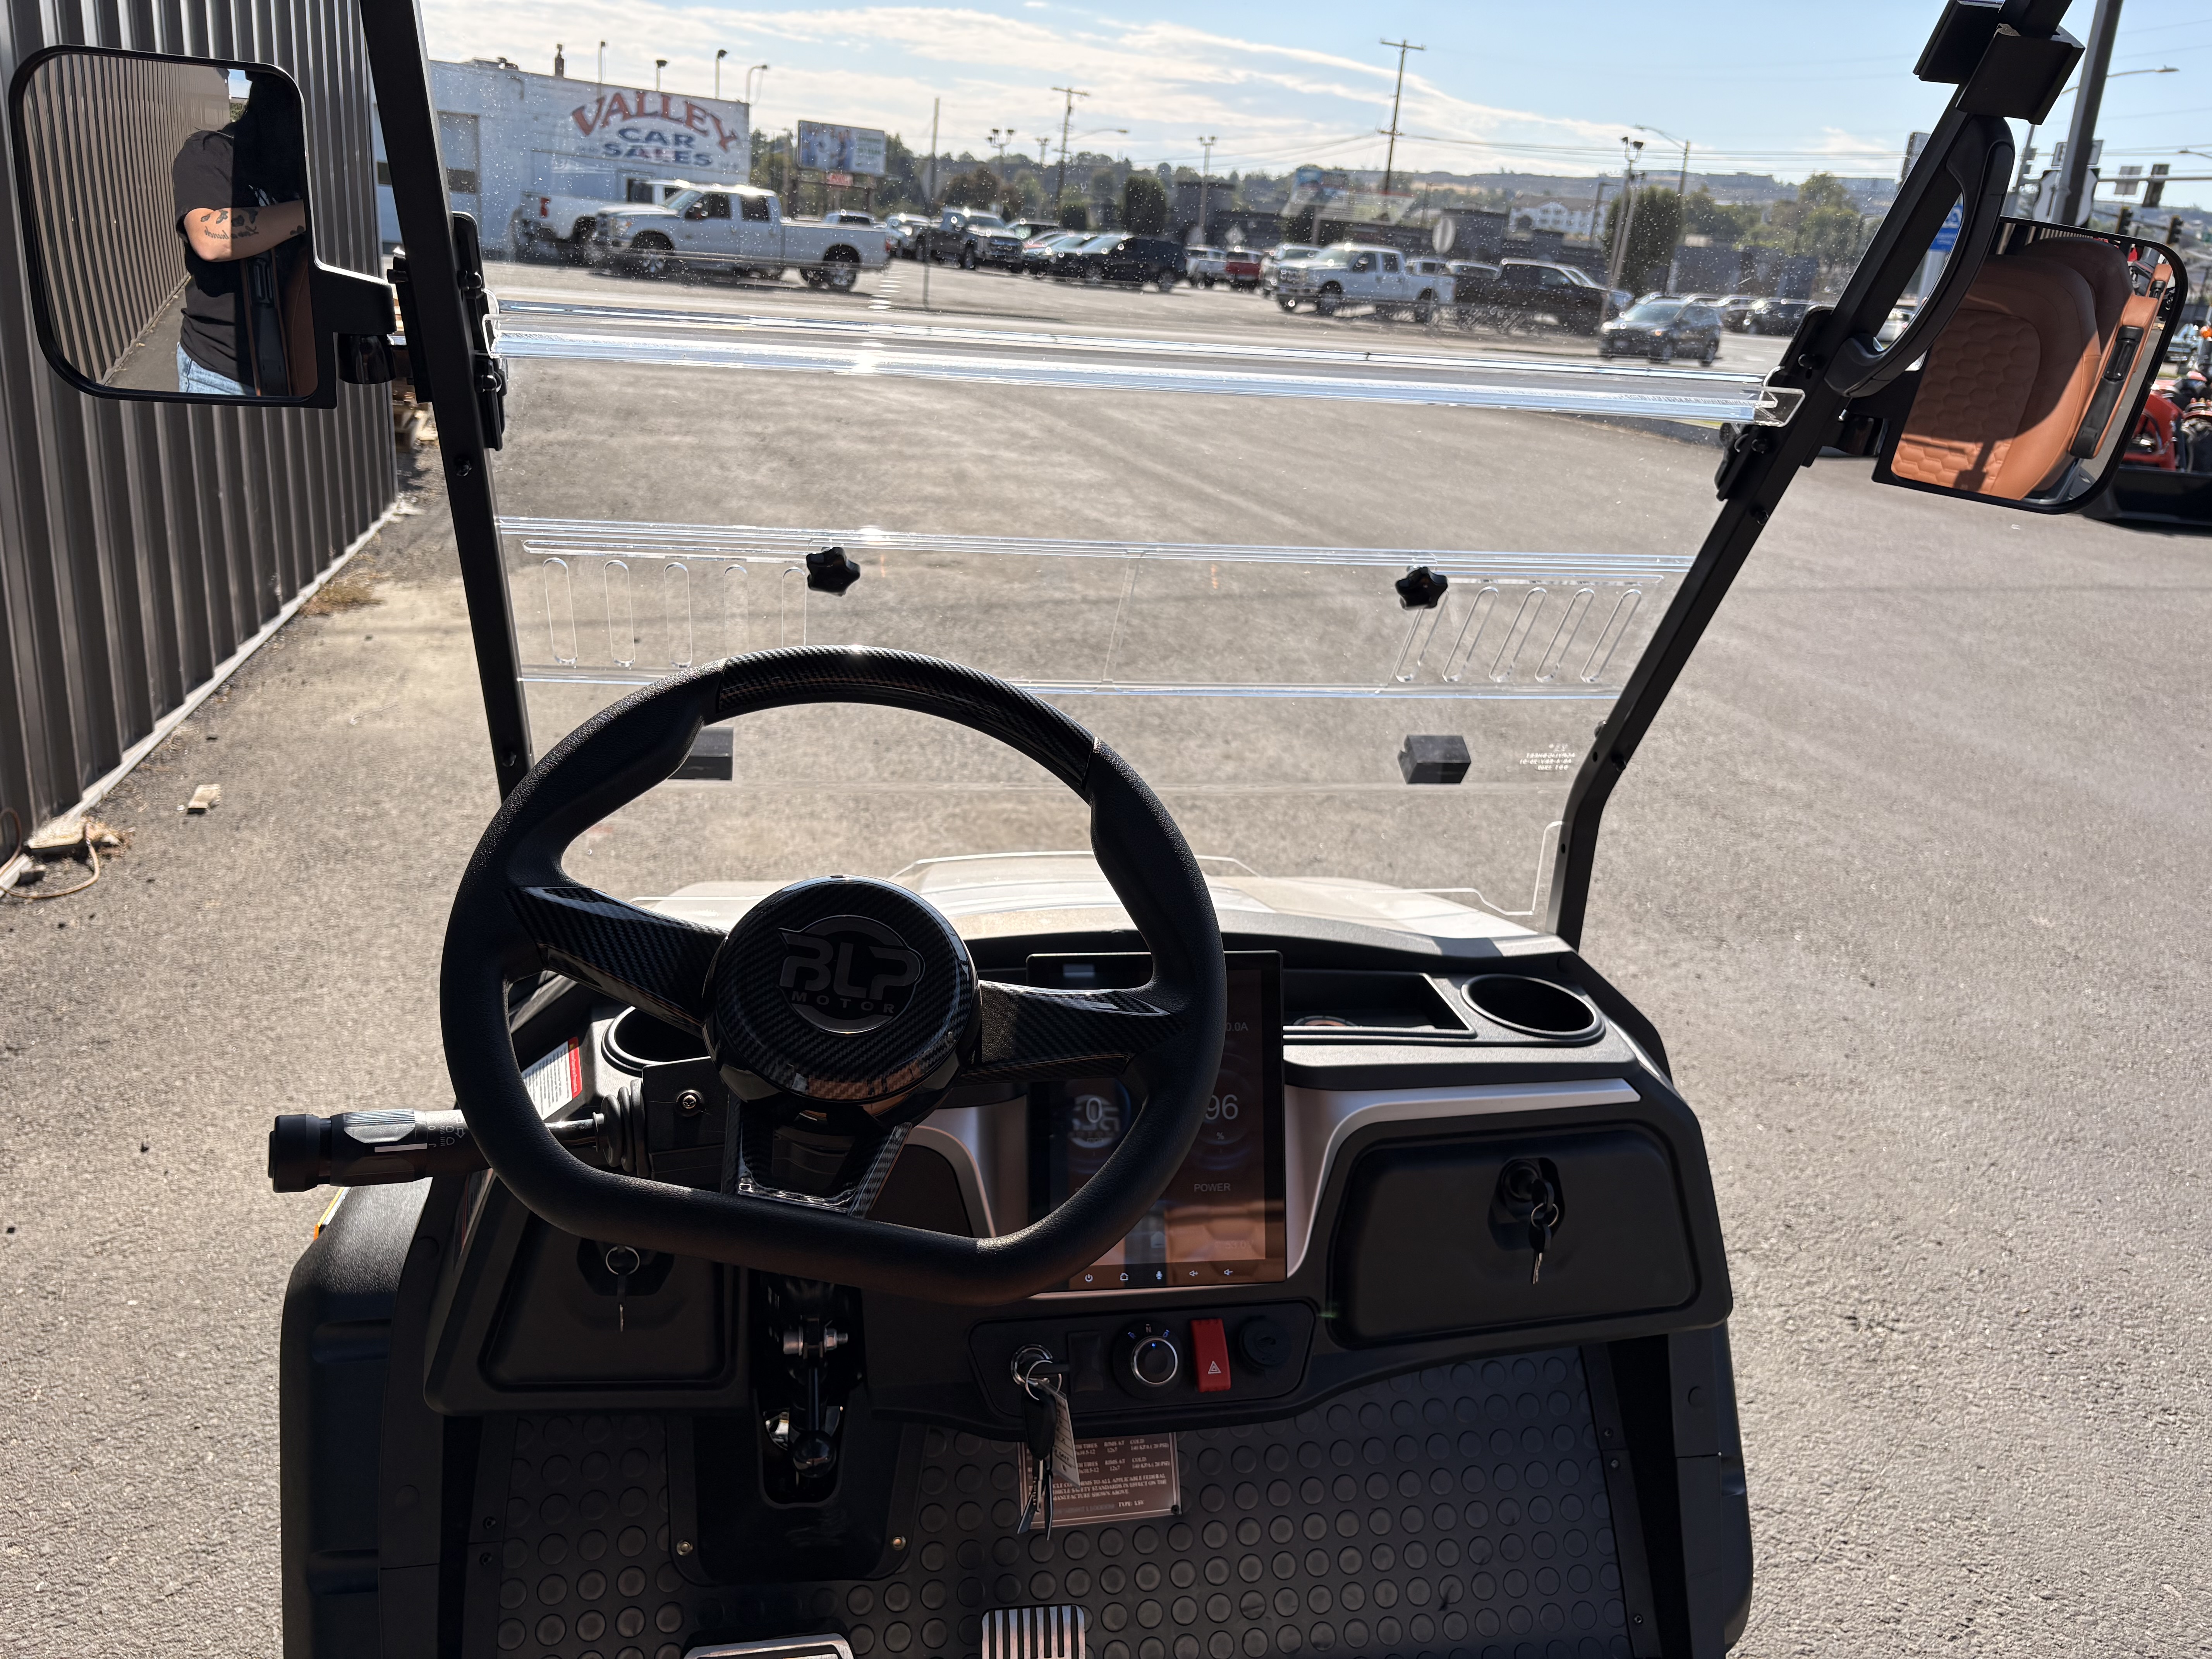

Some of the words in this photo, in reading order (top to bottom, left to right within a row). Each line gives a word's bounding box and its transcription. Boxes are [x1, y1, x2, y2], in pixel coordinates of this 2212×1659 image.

[571, 91, 738, 153] VALLEY
[617, 127, 695, 149] CAR
[602, 143, 713, 167] SALES
[779, 933, 921, 1000] BLP
[792, 991, 895, 1014] MOTOR
[1205, 1094, 1238, 1120] 96
[1194, 1183, 1231, 1192] POWER
